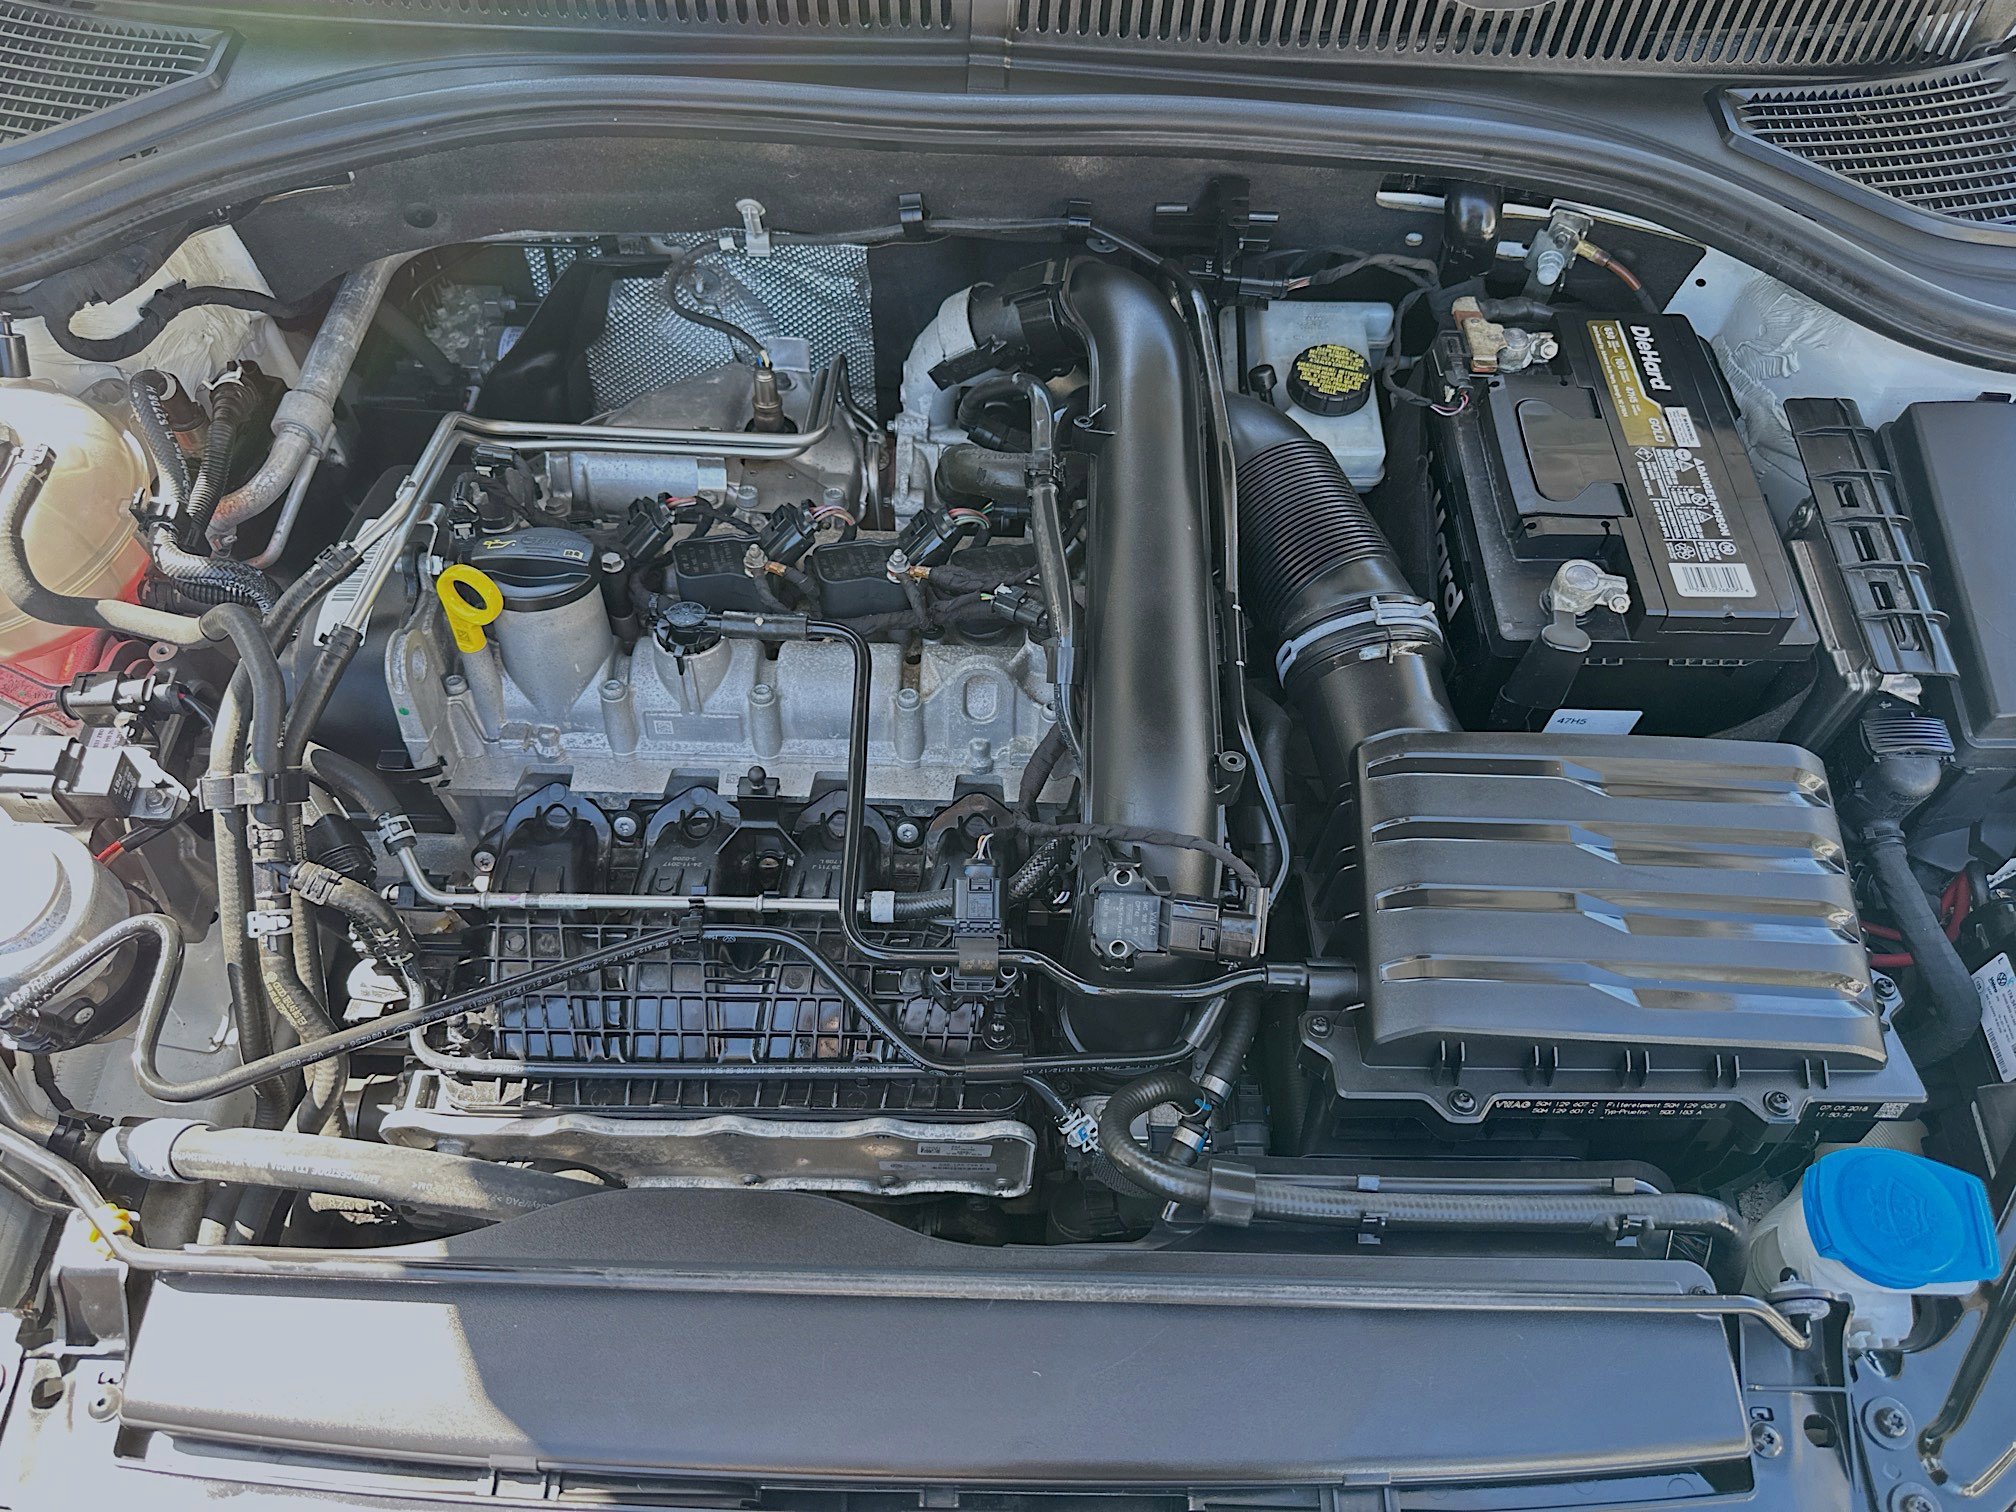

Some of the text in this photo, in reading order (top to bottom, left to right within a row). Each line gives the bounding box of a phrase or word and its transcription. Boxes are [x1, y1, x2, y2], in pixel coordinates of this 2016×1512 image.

[1630, 325, 1672, 391] DieHard
[1648, 417, 1666, 443] GOLD
[1696, 465, 1731, 537] DANGER/POISON
[1557, 717, 1588, 725] 47H5
